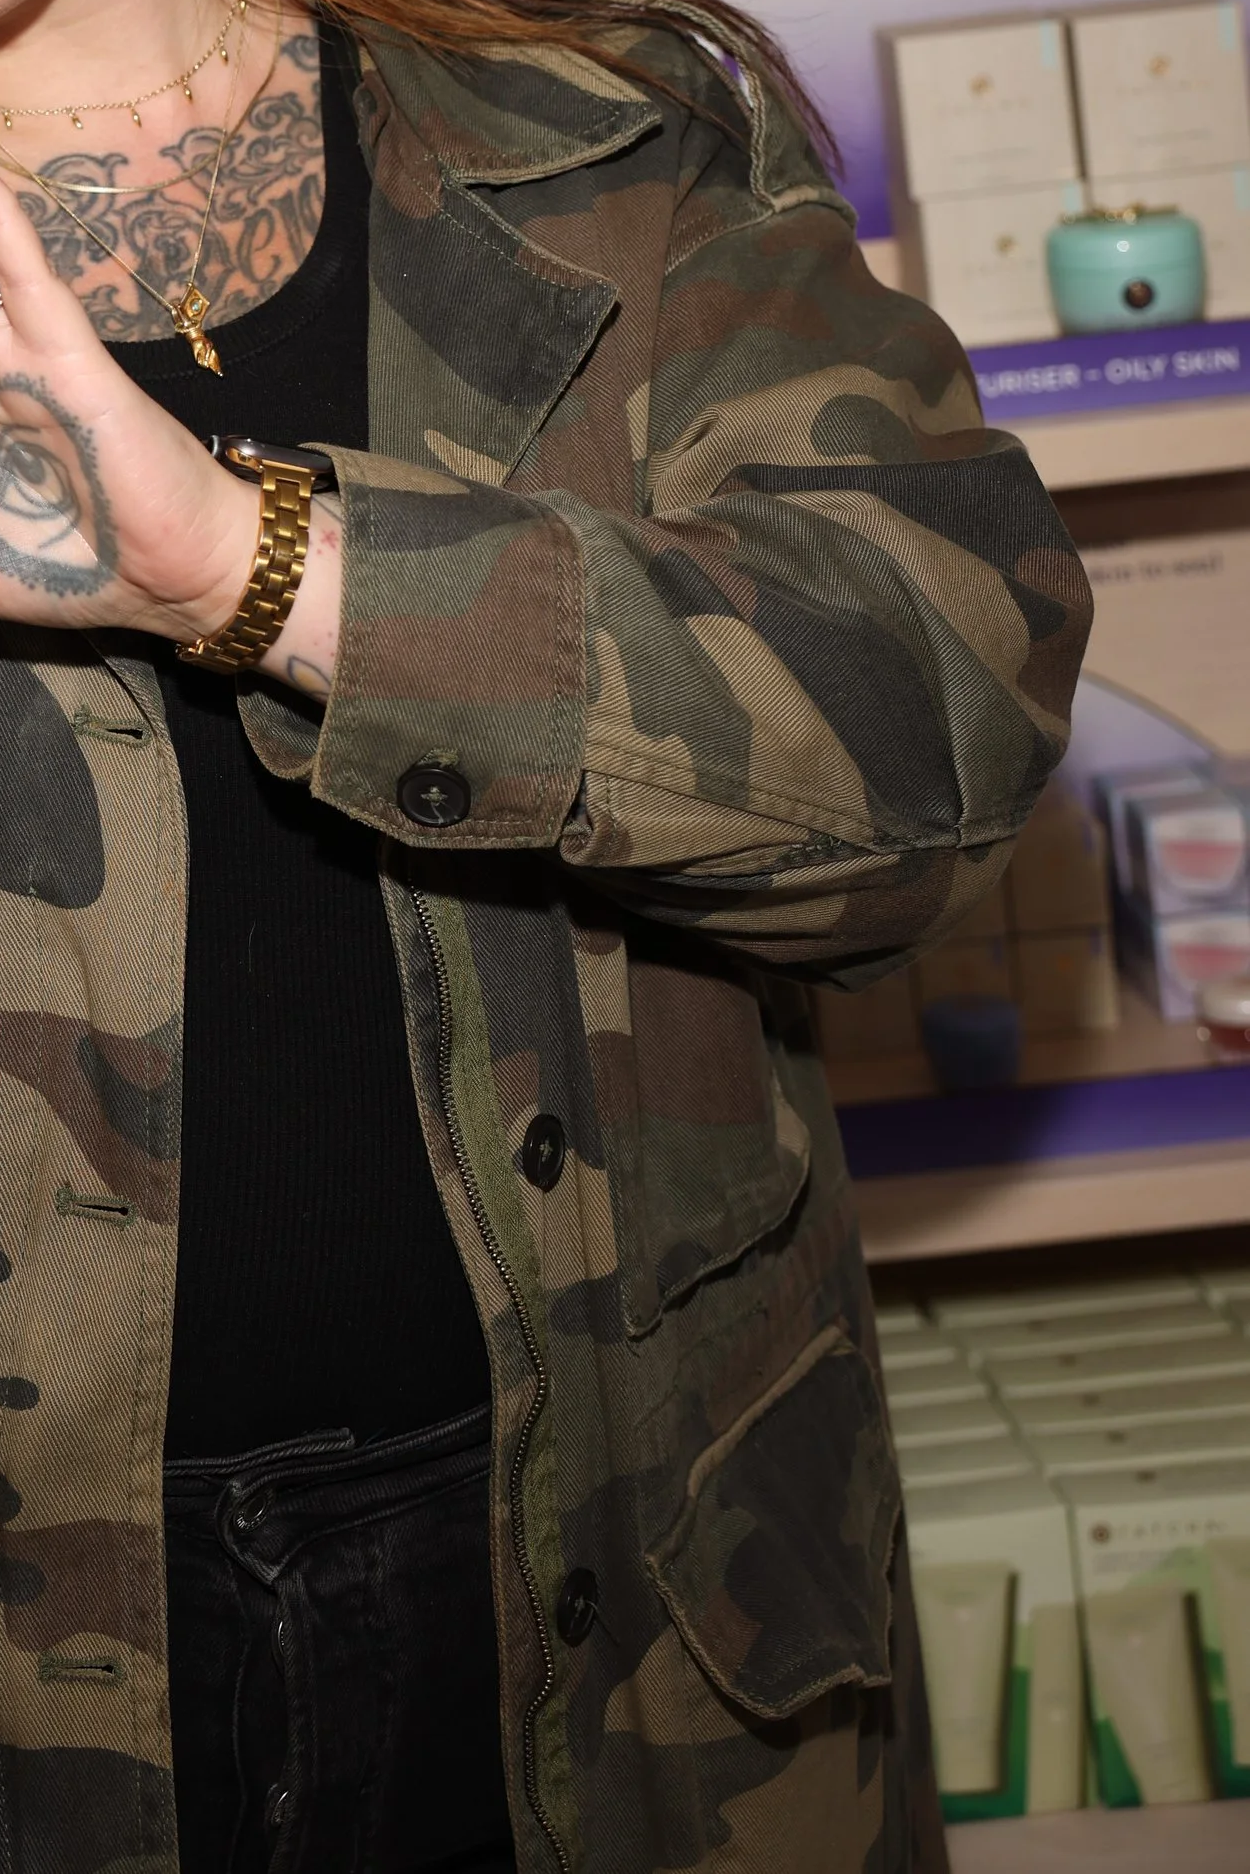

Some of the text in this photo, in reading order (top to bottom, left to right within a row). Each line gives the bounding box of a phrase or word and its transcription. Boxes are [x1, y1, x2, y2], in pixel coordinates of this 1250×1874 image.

[976, 362, 1081, 399] URISER
[1104, 353, 1169, 385] OILY
[1171, 345, 1241, 378] SKIN
